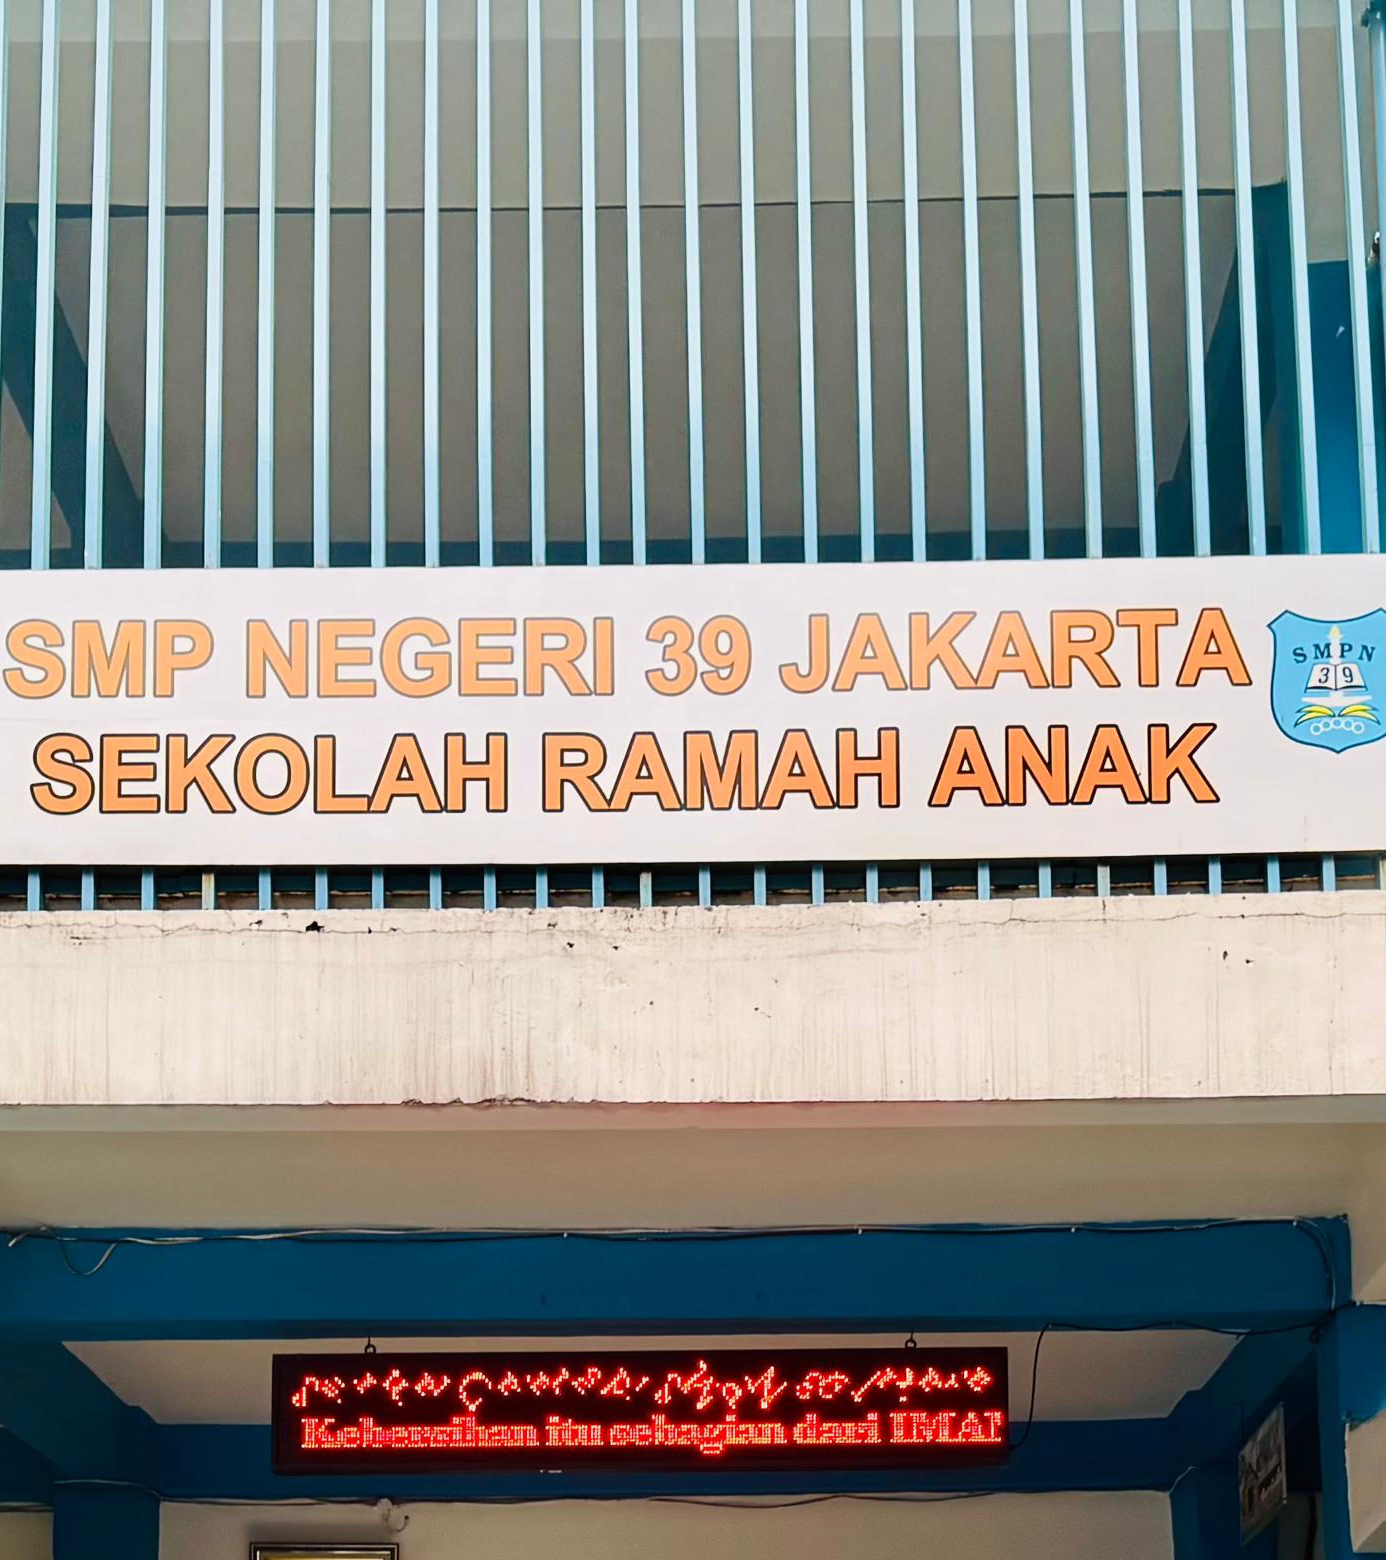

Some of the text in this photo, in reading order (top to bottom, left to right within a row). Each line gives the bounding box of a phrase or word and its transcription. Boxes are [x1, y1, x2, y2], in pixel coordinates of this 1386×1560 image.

[2, 607, 1253, 699] SMP NEGERI 39 JAKARTA
[29, 722, 1221, 817] SEKOLAH RAMAH ANAK
[793, 1411, 882, 1445] dari
